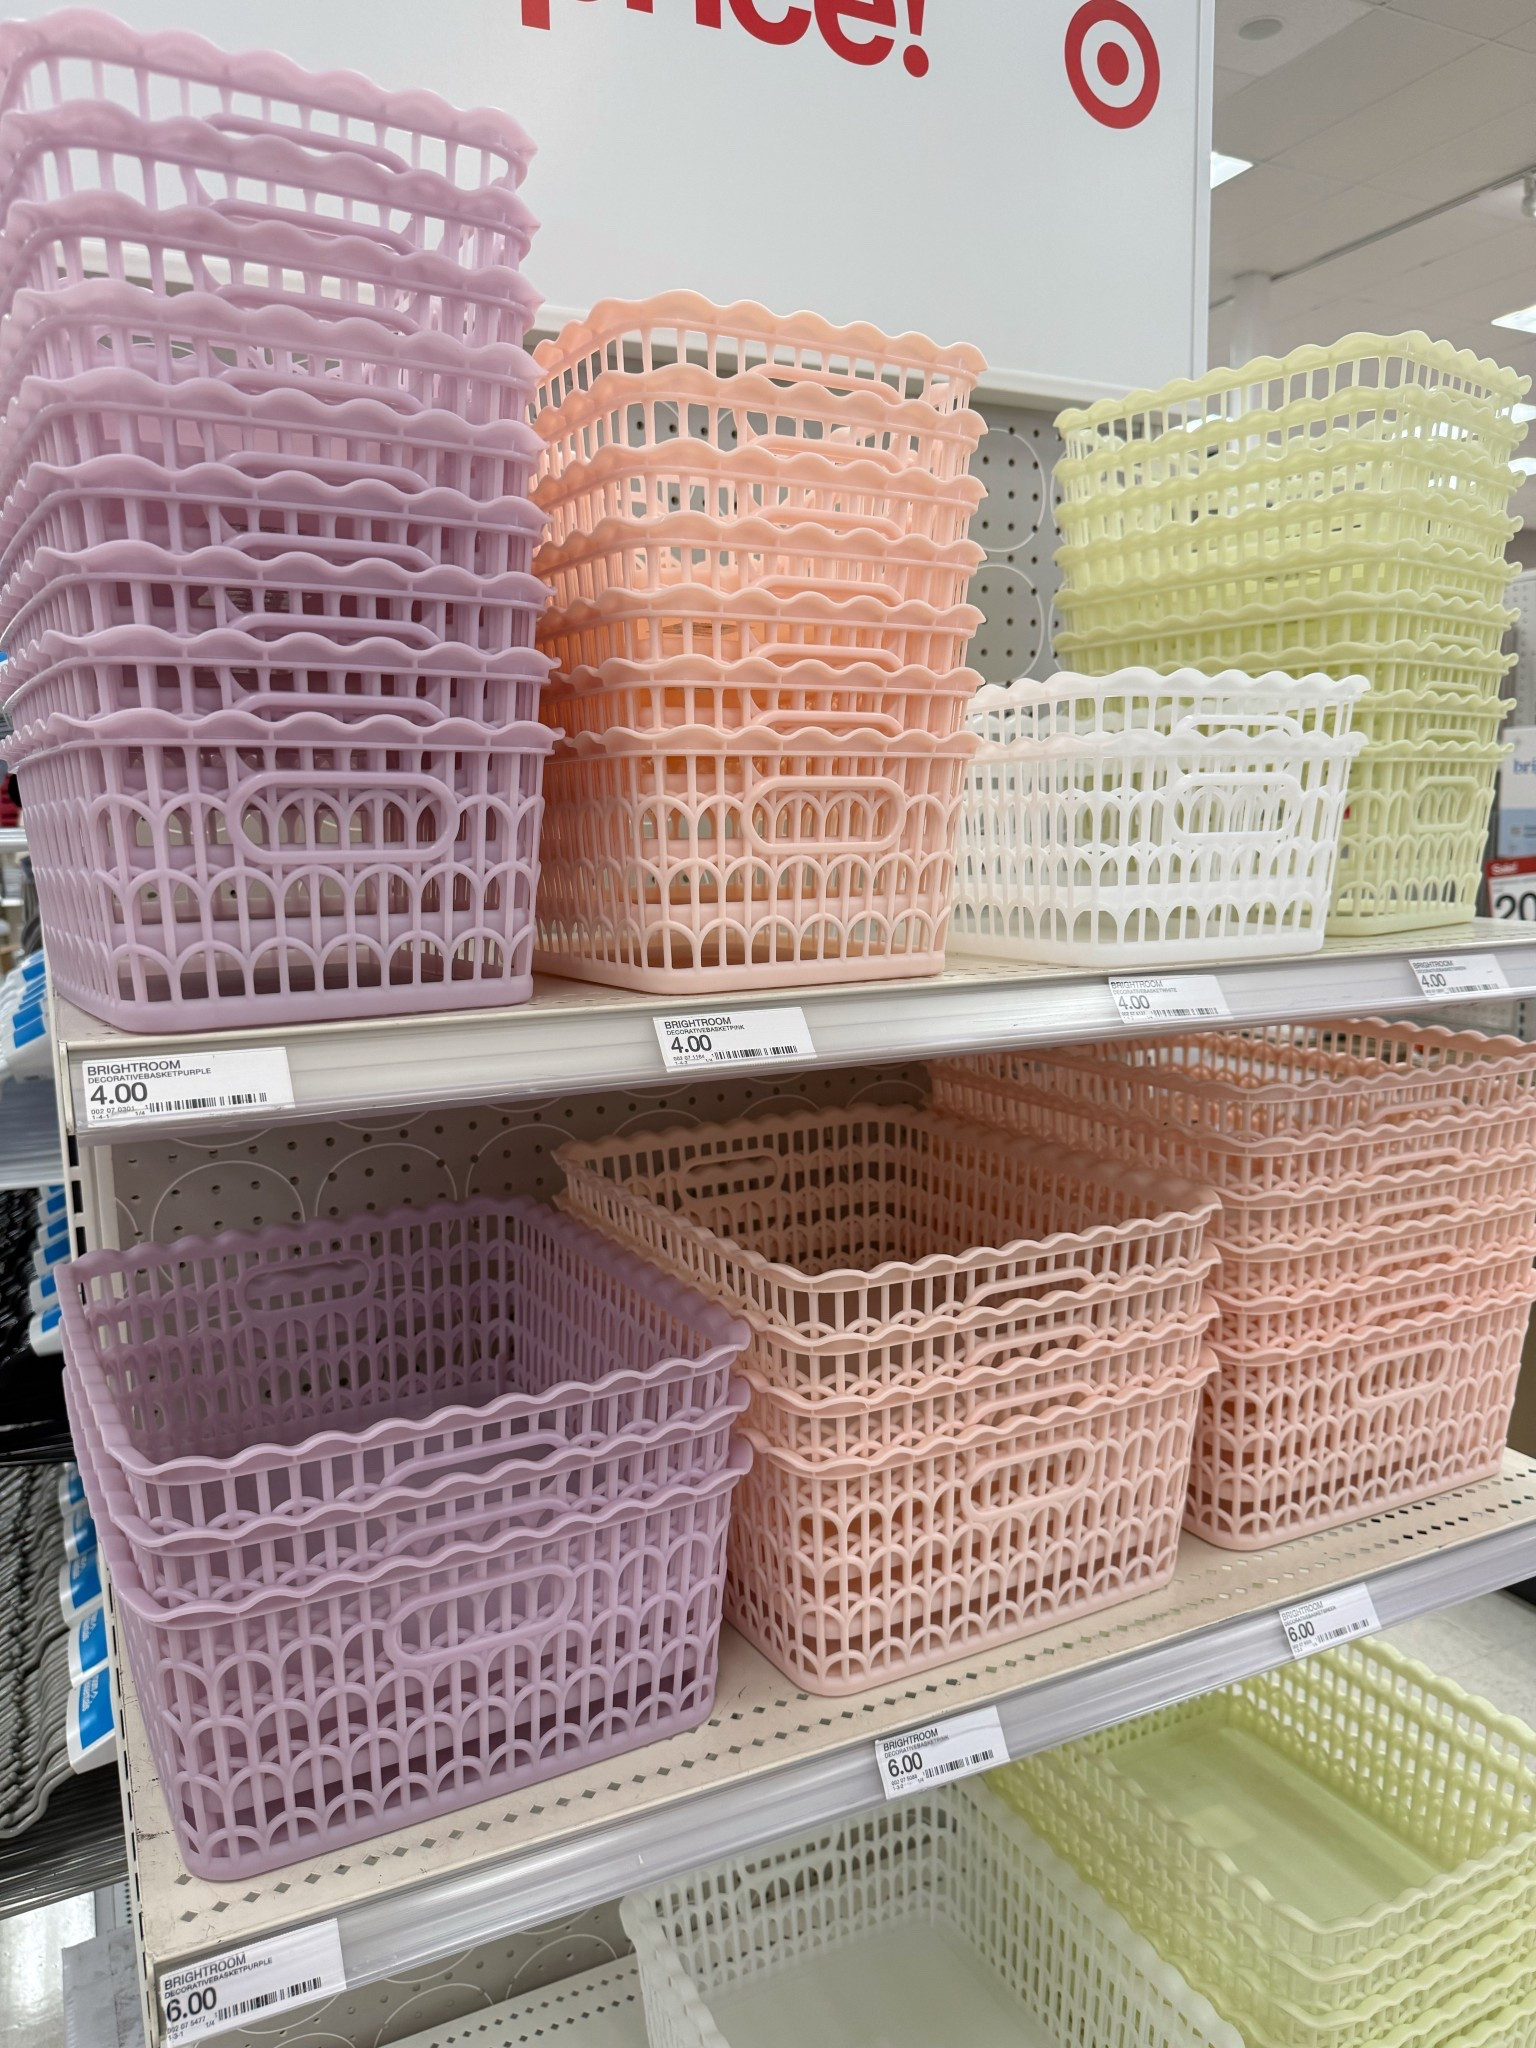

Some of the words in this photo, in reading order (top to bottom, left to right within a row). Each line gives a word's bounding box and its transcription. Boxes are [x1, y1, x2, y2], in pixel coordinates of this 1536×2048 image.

[1413, 960, 1454, 969] BRIGHTROOM
[1110, 980, 1163, 989] BRIGHTROOM
[1421, 974, 1447, 988] 4.00
[1119, 995, 1150, 1010] 4.00
[664, 1017, 732, 1029] BRIGHTROOM
[666, 1025, 745, 1036] DECORATIVEBASKETPINK
[671, 1035, 712, 1053] 4.00
[87, 1060, 181, 1076] BRIGHTROOM
[88, 1067, 212, 1084] DECORATIVEBASKETPURPLE
[90, 1081, 148, 1105] 4.00
[1281, 1600, 1324, 1621] BRIGHTROOM
[1288, 1620, 1315, 1642] 6.00
[883, 1727, 939, 1752] BRIGHTROOM
[888, 1751, 923, 1777] 6.00
[164, 1953, 247, 1991] BRIGHTROOM
[164, 1957, 273, 2000] DECORATIVEBASKETPURPLE
[166, 1986, 217, 2023] 6.00
